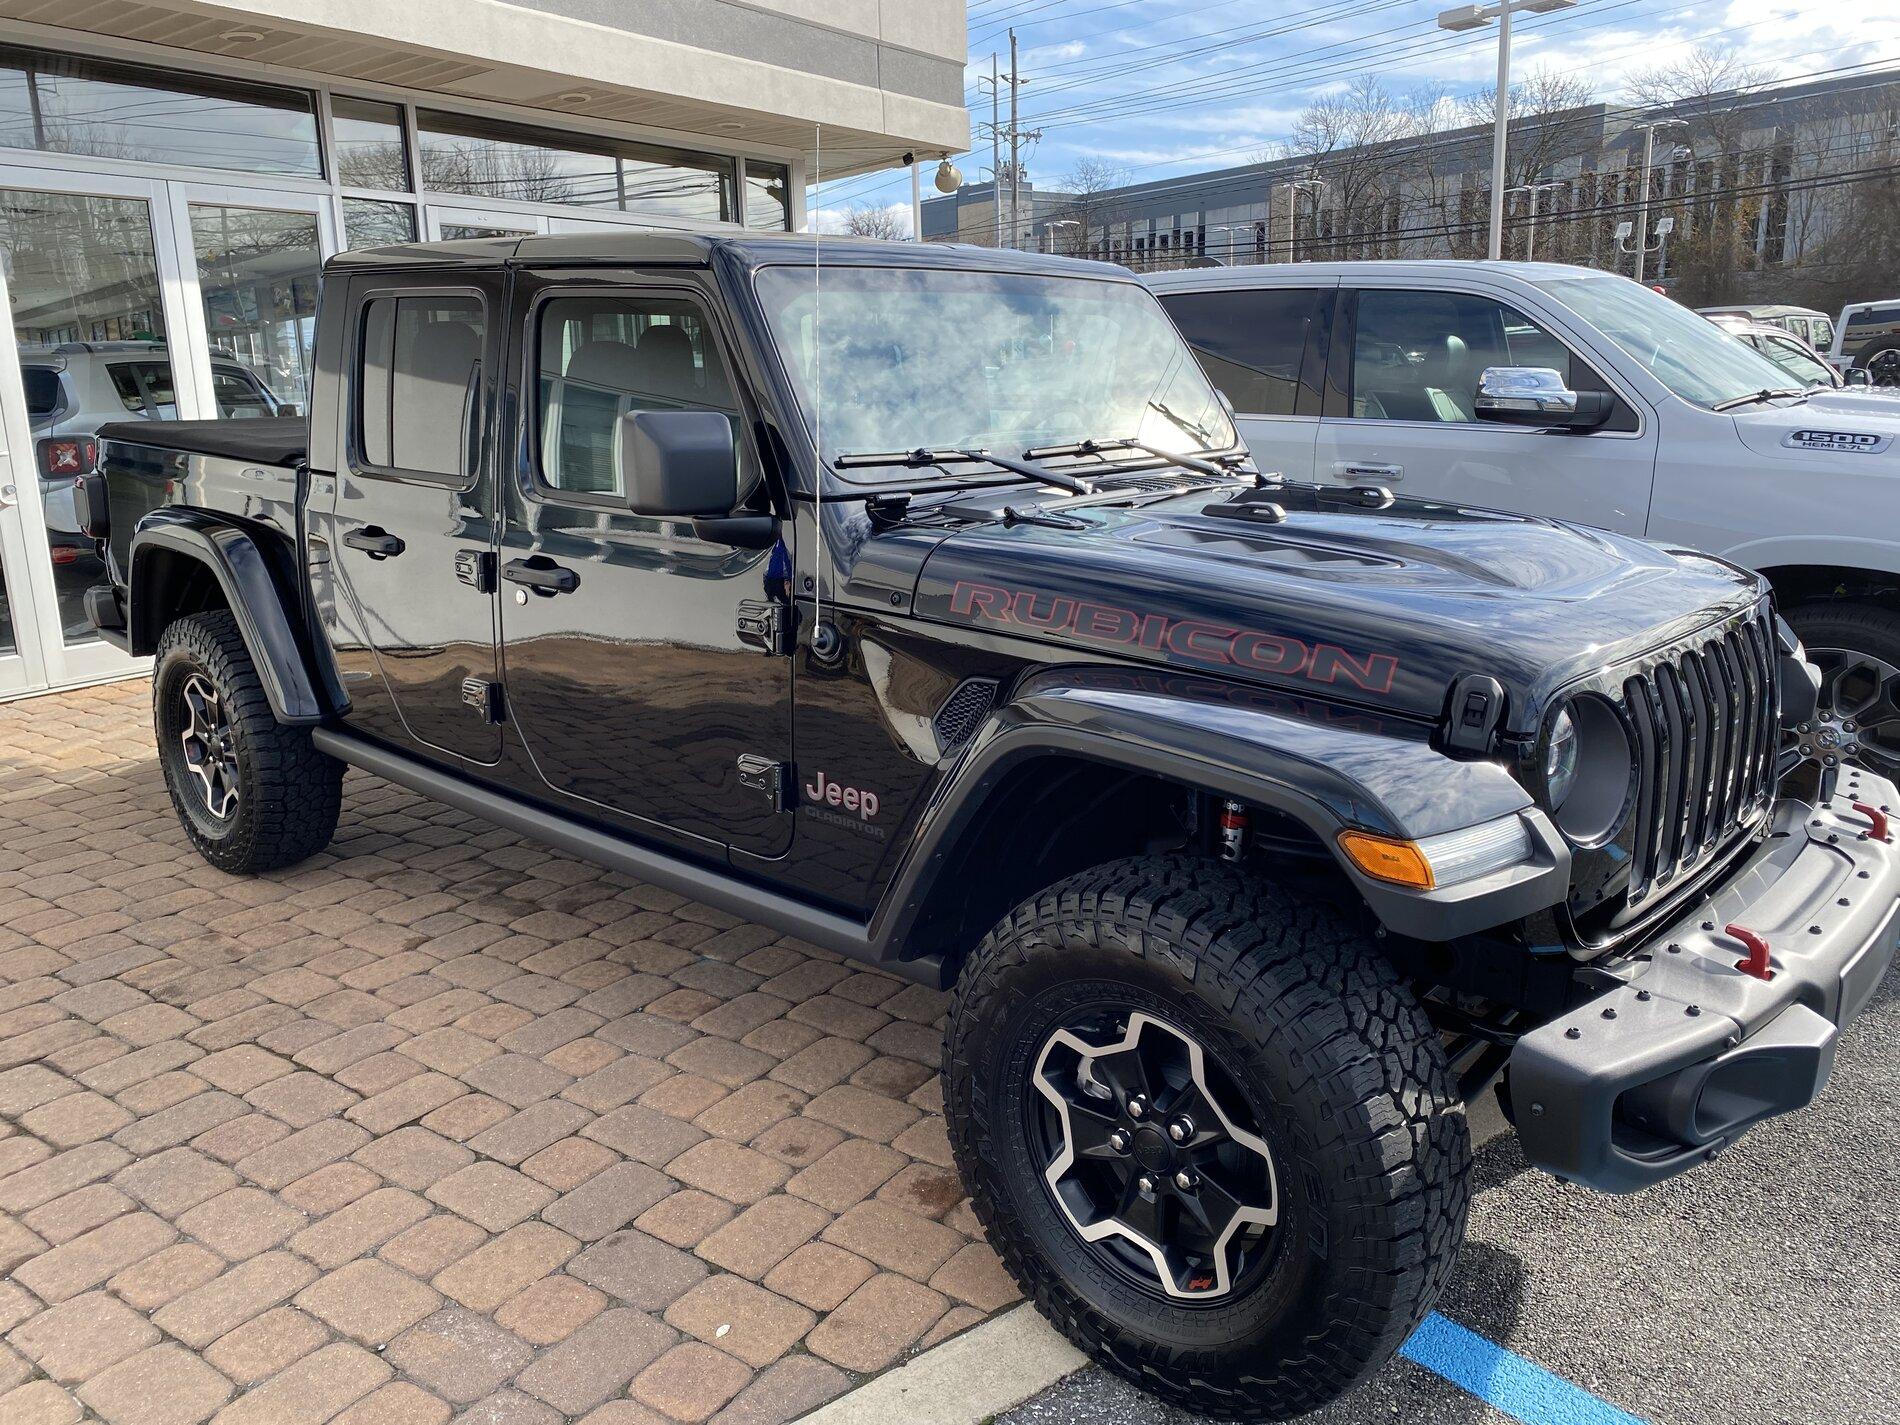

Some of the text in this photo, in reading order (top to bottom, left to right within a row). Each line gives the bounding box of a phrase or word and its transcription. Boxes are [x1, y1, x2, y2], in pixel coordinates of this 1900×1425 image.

[1802, 432, 1876, 444] 1500
[950, 580, 1399, 694] RUBICON
[806, 771, 880, 821] Jeep
[805, 806, 885, 837] GLADIATOR
